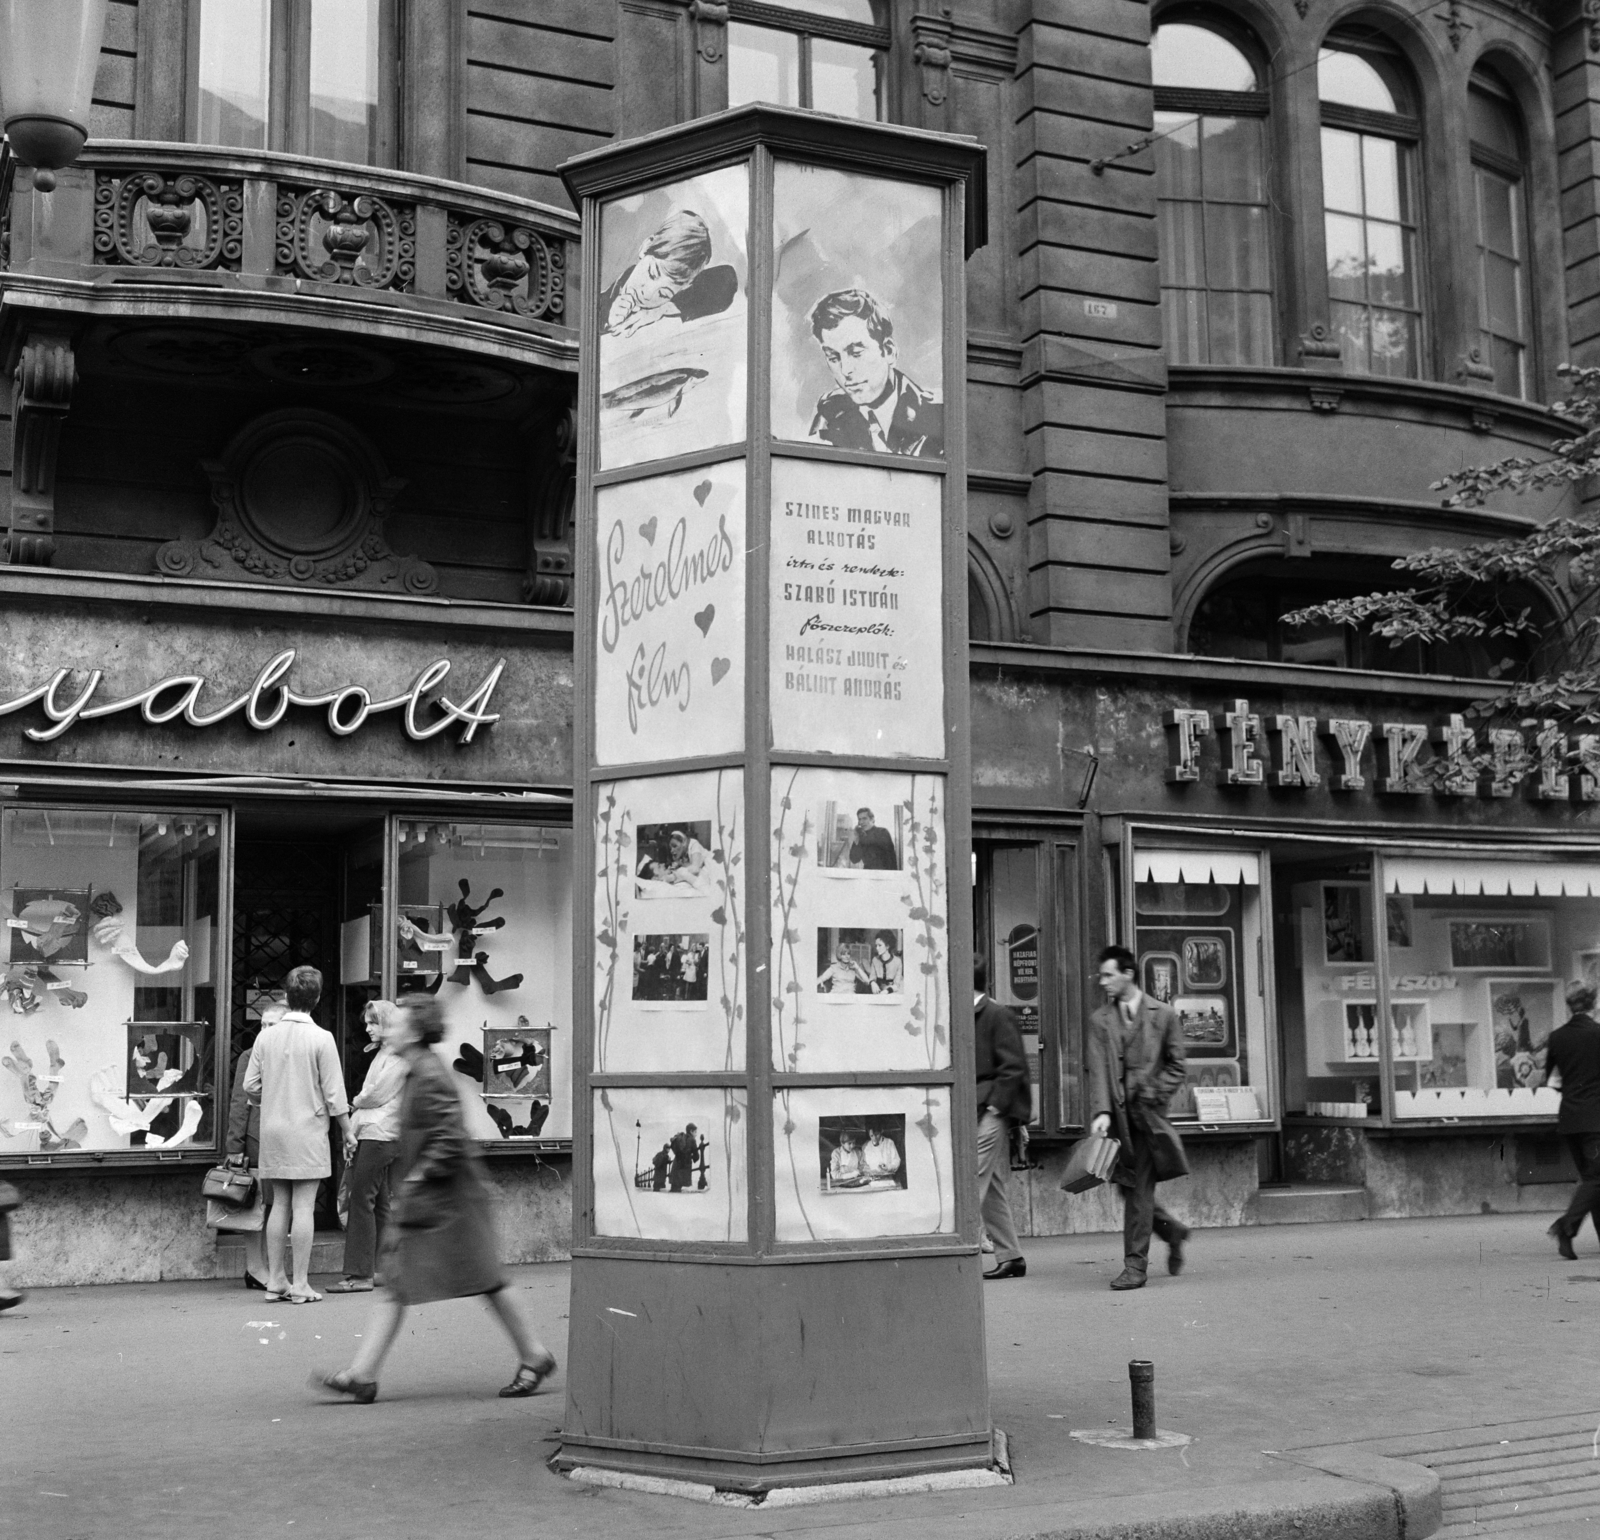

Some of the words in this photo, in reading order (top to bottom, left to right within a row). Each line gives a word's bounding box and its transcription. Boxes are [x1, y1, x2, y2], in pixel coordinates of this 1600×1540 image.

[847, 507, 911, 528] MAGYAR
[807, 527, 876, 551] ALKOTÁS
[818, 557, 836, 571] és
[602, 512, 734, 654] Szerelmes
[784, 579, 836, 605] SZABÓ
[843, 584, 899, 611] ISTVÁN
[800, 613, 895, 637] főszereplők:
[786, 637, 843, 666] HALÁSZ
[847, 650, 890, 670] JUDIT
[892, 655, 908, 671] és
[626, 641, 692, 735] film
[785, 664, 838, 696] BÁLINT
[843, 673, 902, 701] ANDRÁS
